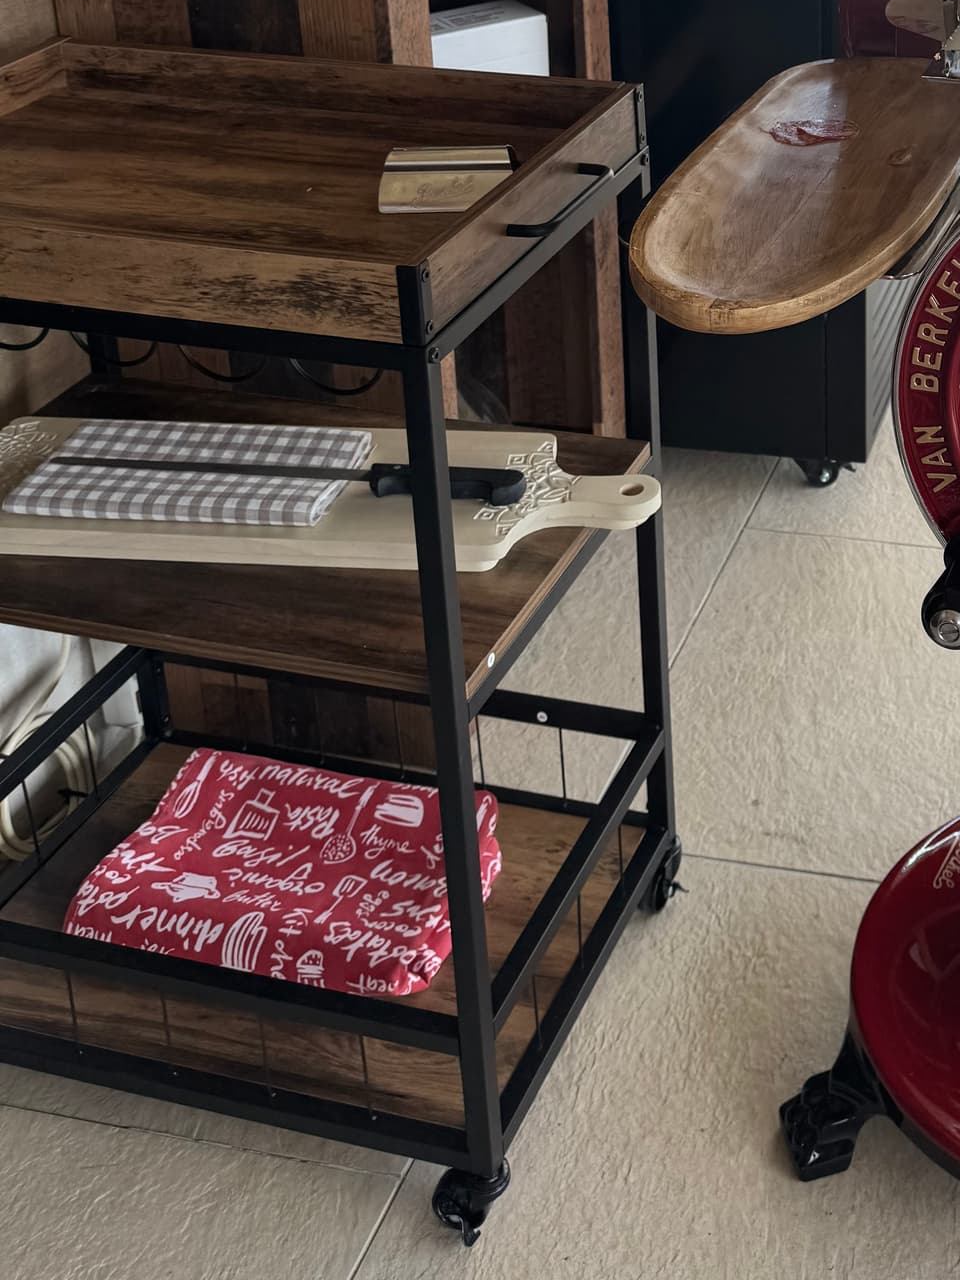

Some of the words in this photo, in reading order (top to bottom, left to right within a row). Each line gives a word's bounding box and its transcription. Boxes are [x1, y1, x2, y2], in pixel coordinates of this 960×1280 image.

[912, 425, 958, 493] VAN
[258, 765, 365, 798] natural
[173, 788, 235, 861] asparagus
[359, 823, 417, 860] thyme
[220, 862, 326, 896] organic
[222, 889, 285, 912] butter
[111, 904, 225, 952] dinner
